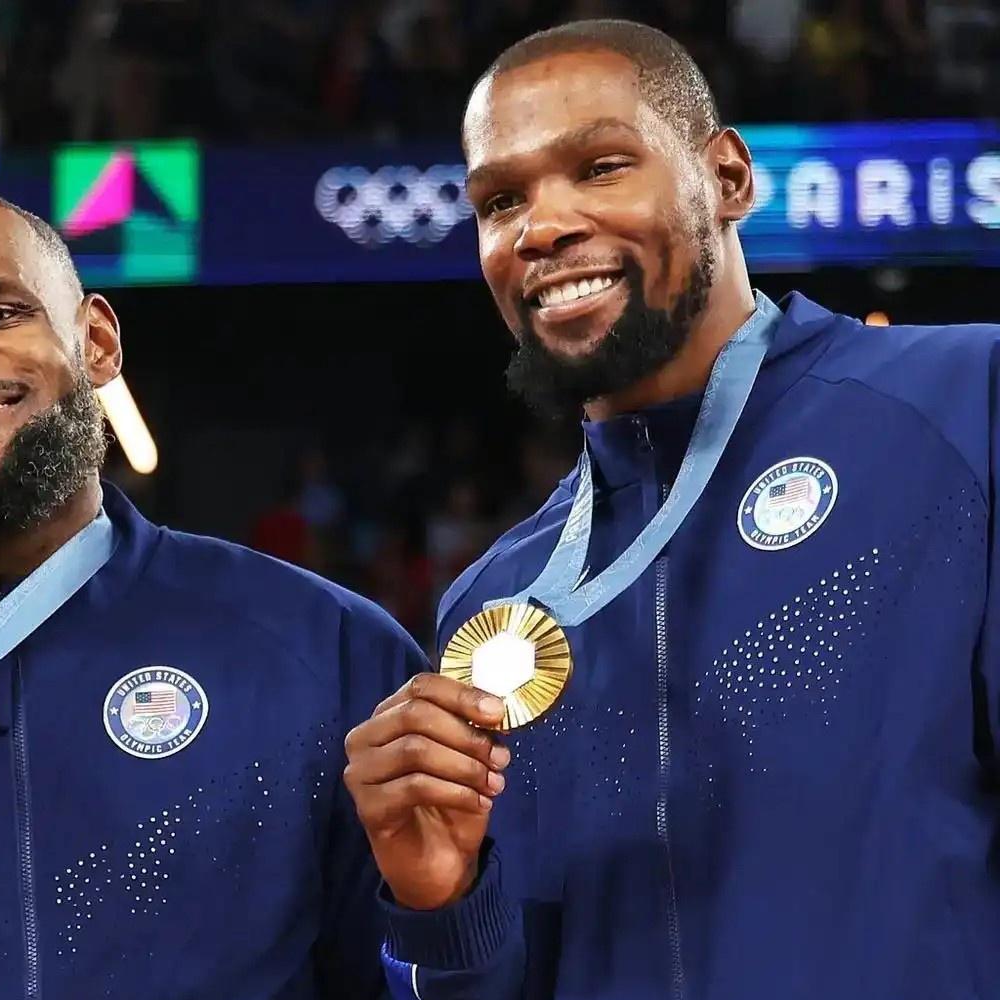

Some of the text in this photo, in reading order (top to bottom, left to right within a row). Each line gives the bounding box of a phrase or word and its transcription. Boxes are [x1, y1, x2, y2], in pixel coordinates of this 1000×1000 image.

[753, 463, 825, 494] UNITED STATES
[750, 514, 821, 545] OLYMPIC TEAM
[117, 671, 193, 697] UNITED STATES
[119, 728, 193, 753] OLYMPIC TEAM
